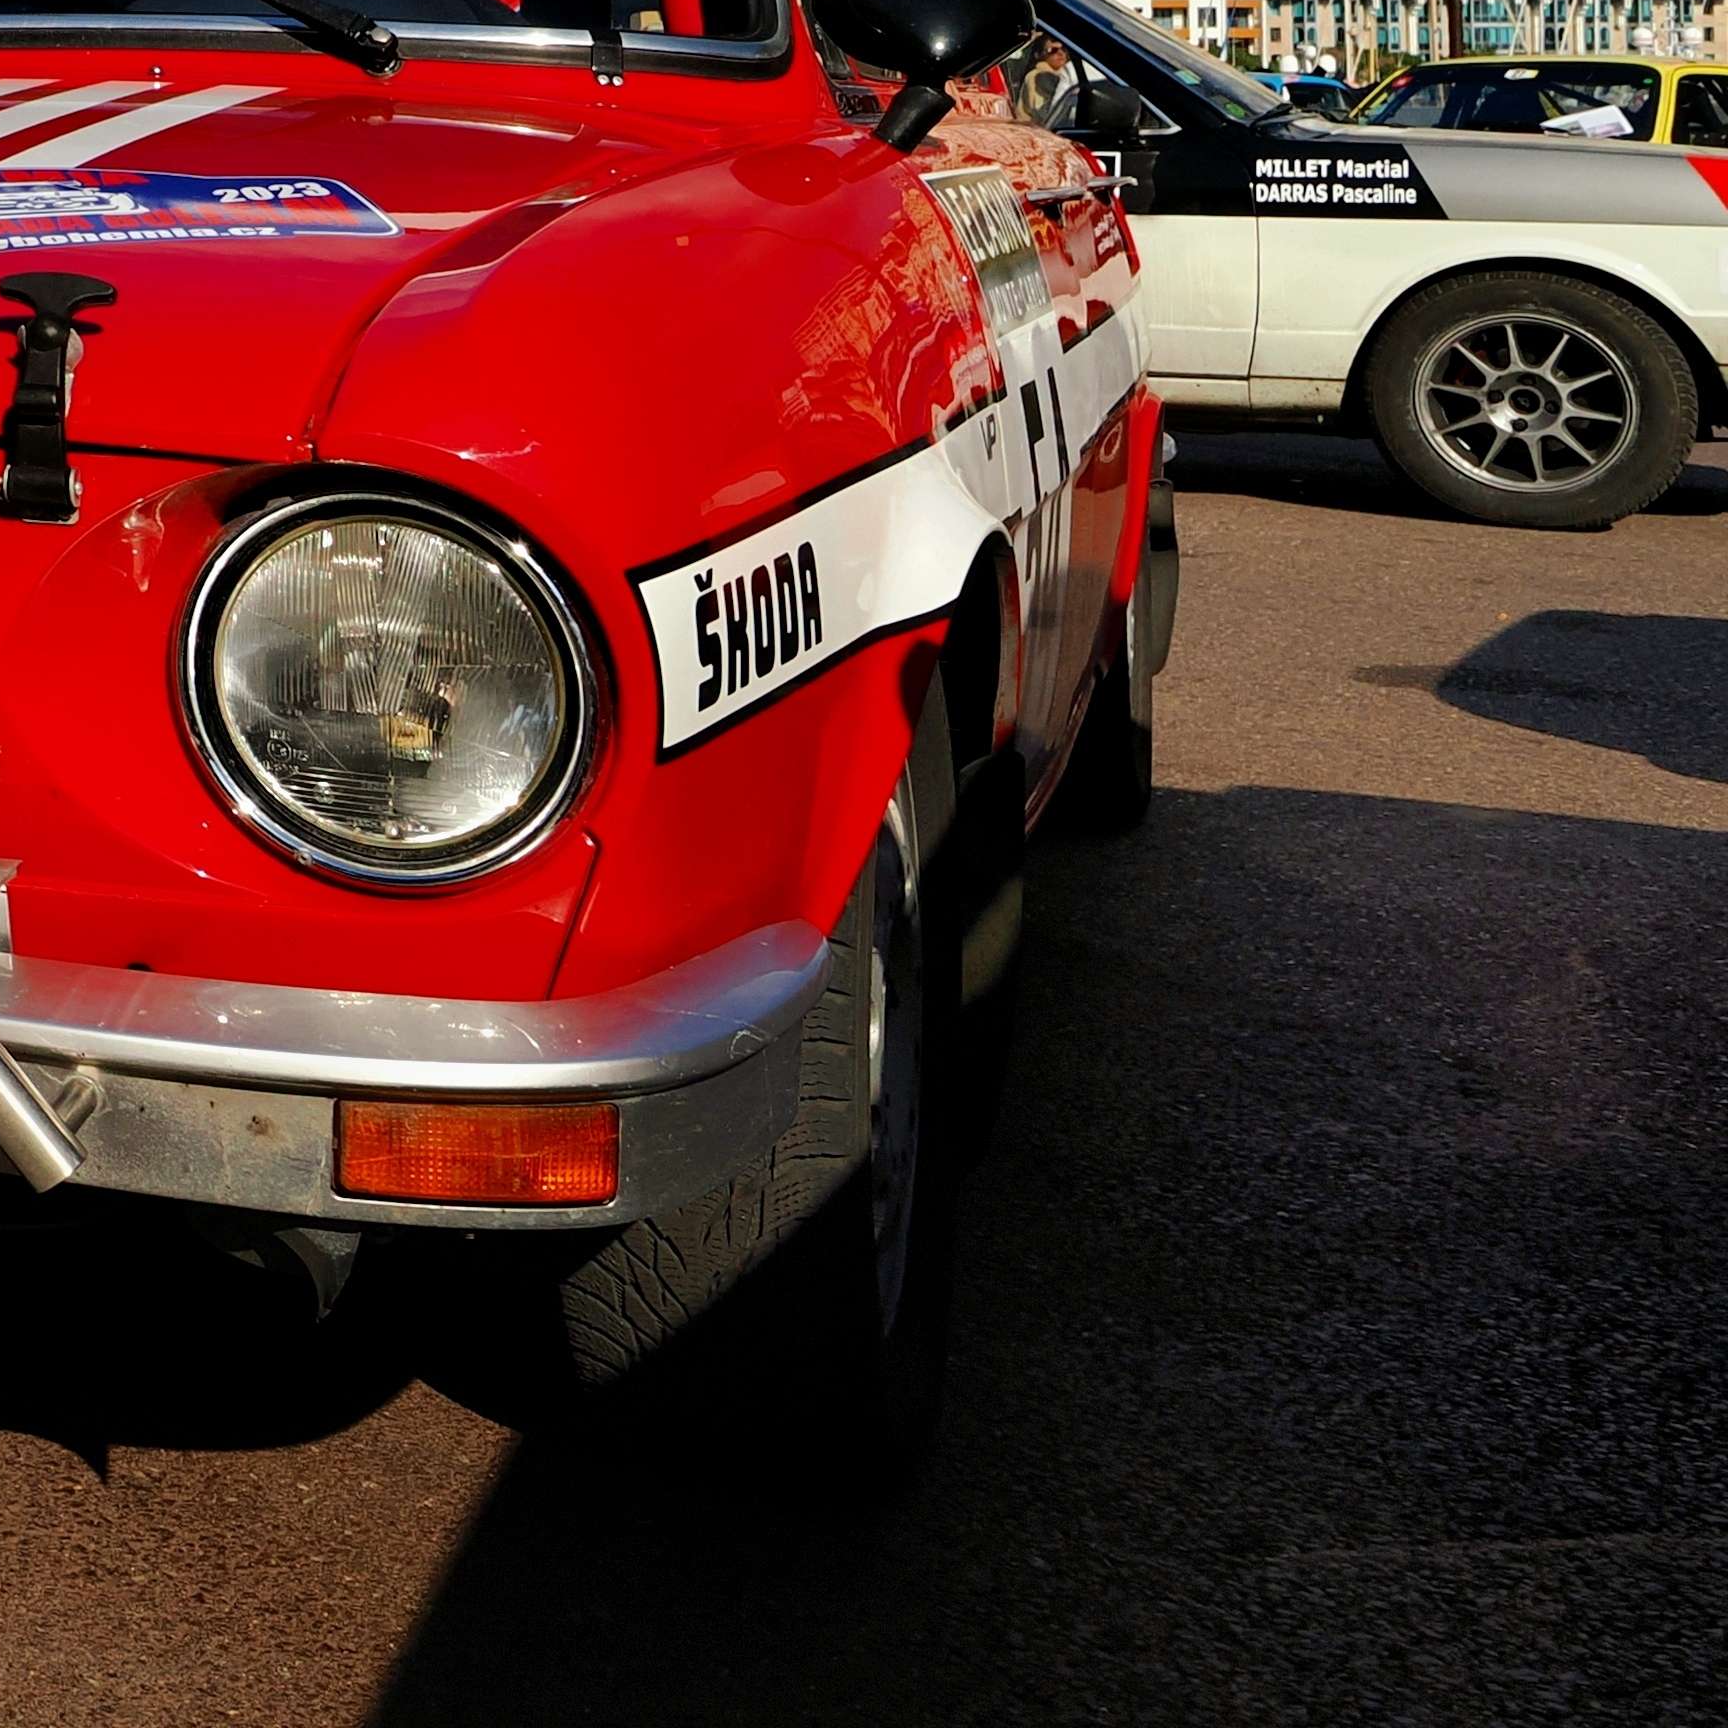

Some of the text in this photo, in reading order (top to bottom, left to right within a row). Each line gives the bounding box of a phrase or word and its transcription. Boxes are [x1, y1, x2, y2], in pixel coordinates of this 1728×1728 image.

[1255, 158, 1410, 179] MILLET Martial
[211, 181, 333, 204] 2023
[1255, 183, 1417, 204] DARRAS Pascaline
[693, 541, 823, 713] ŠKODA
